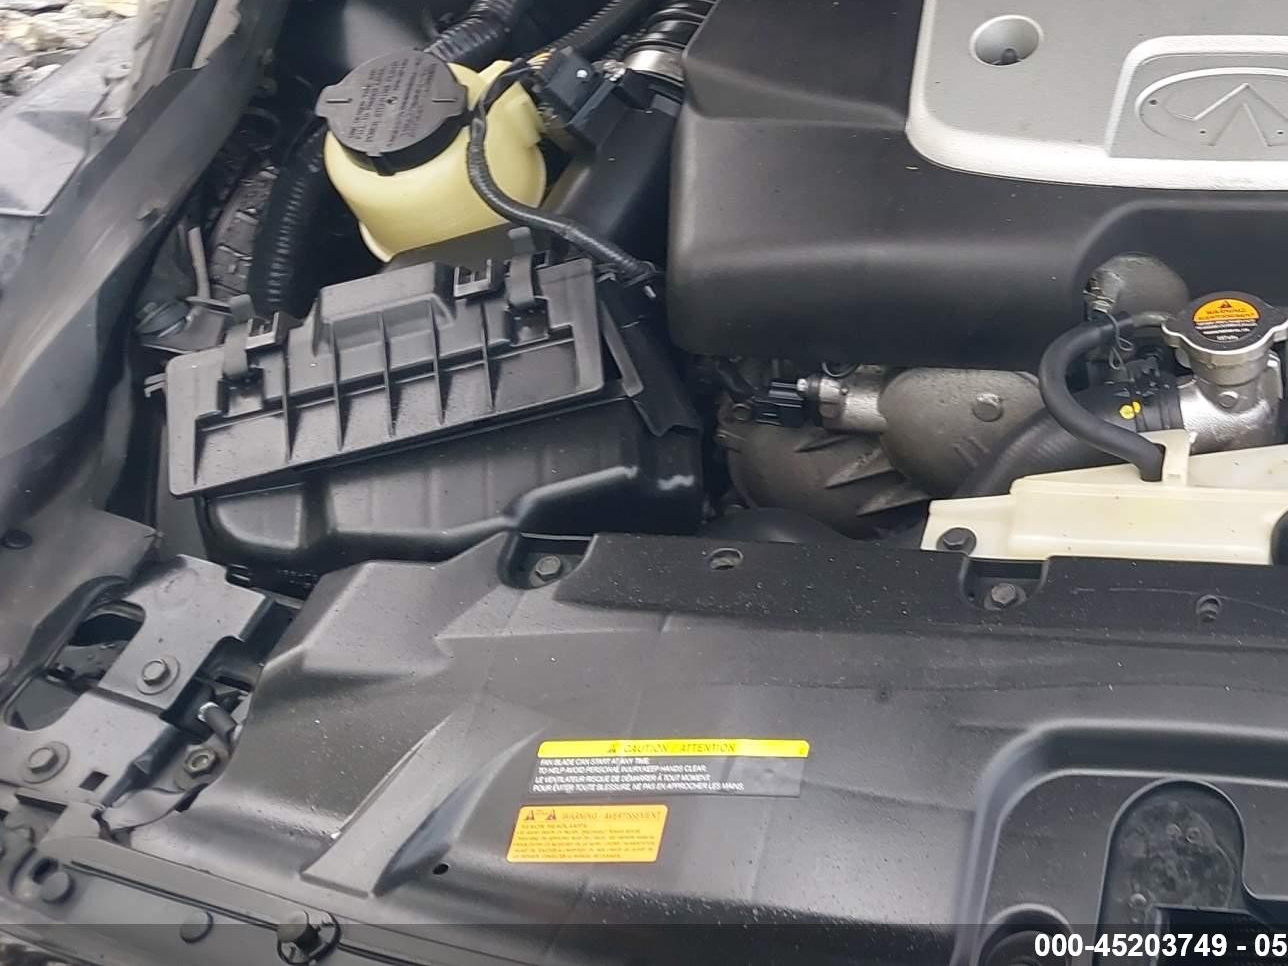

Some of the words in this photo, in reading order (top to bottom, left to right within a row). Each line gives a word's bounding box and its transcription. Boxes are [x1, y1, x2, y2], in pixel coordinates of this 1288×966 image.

[623, 743, 668, 753] CAUTION
[679, 743, 736, 753] ATTENTION
[575, 758, 590, 766] CAN
[620, 757, 634, 765] ANY
[548, 766, 565, 774] HELP
[566, 766, 585, 774] AVOID
[632, 783, 642, 791] NE
[708, 783, 721, 791] LES
